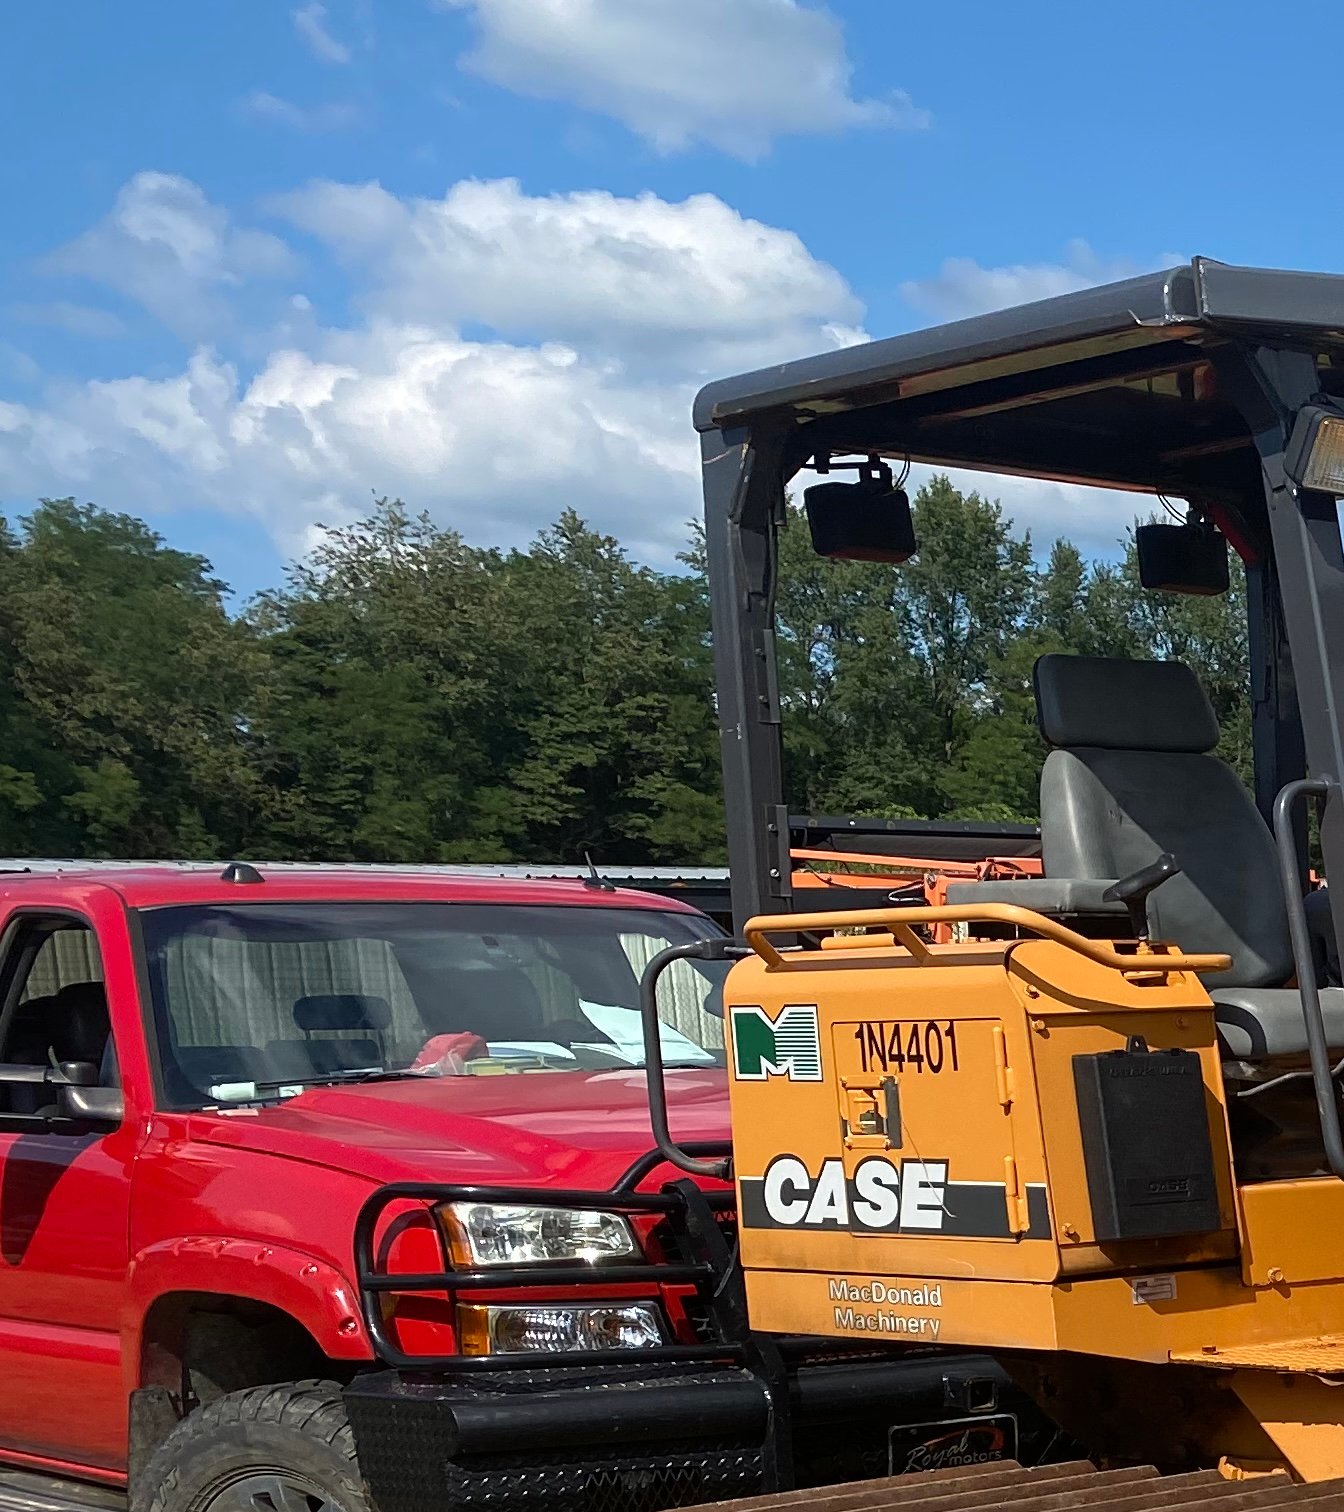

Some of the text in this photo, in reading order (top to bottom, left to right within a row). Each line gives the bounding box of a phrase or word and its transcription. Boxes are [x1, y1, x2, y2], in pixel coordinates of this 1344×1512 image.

[855, 1019, 959, 1074] 1N4401
[762, 1154, 949, 1229] CASE
[828, 1278, 942, 1308] MacDonald
[834, 1306, 940, 1341] Machinery
[902, 1429, 970, 1475] Royal
[949, 1450, 1002, 1465] motors
